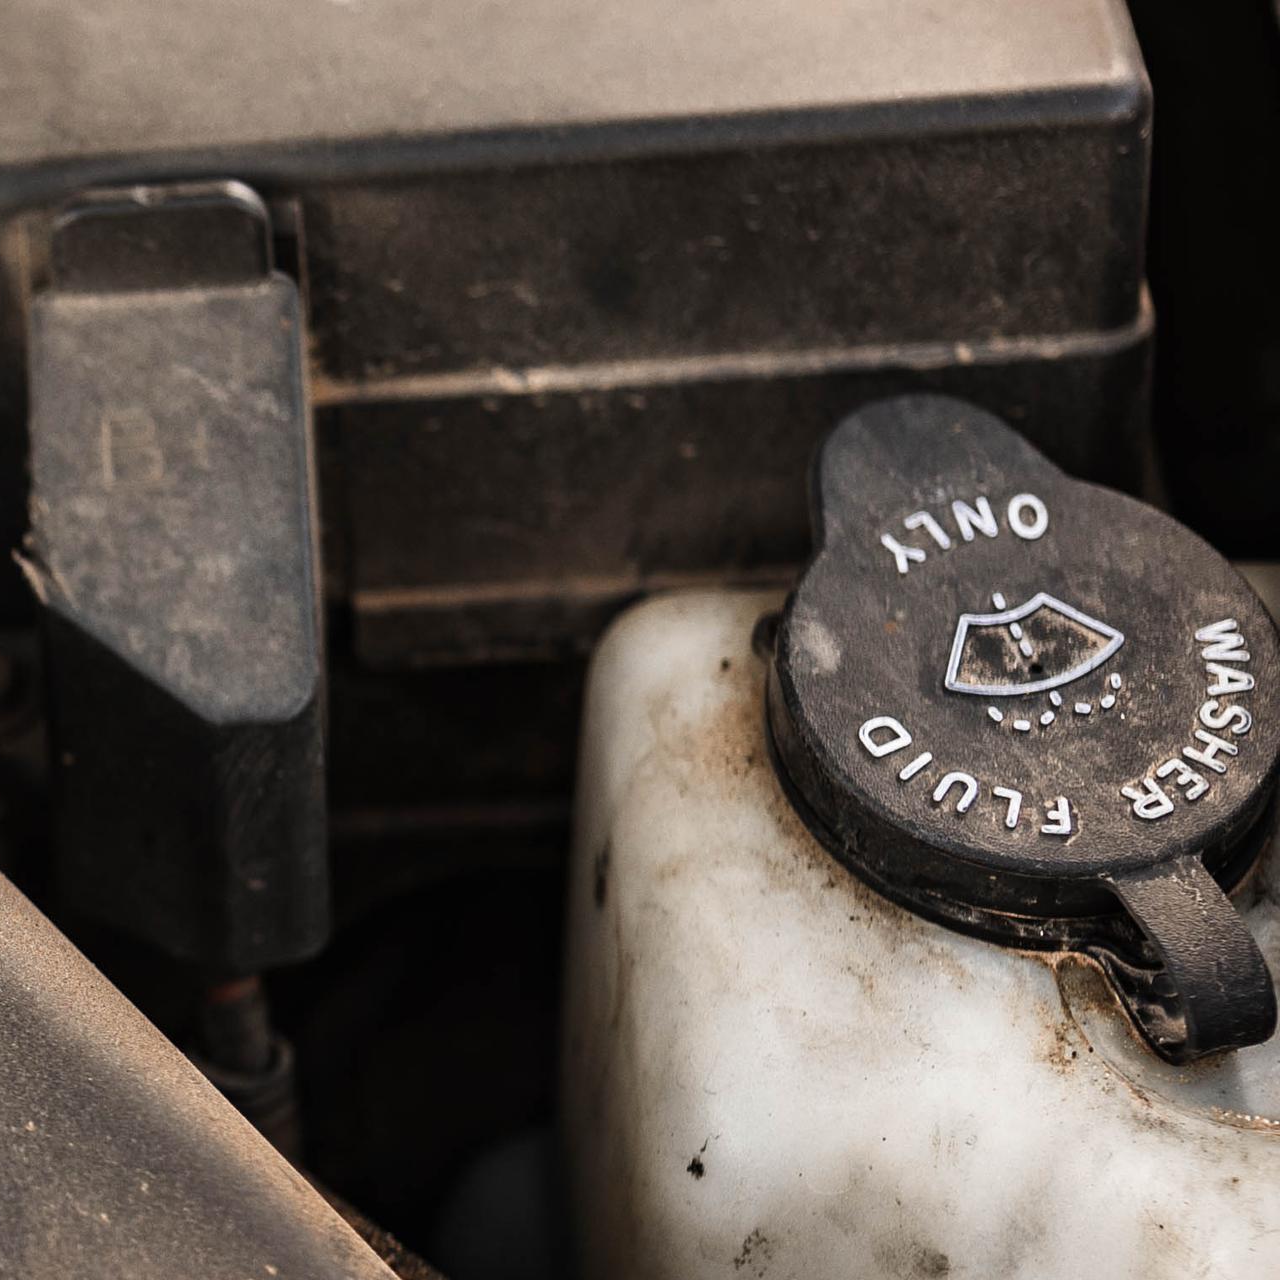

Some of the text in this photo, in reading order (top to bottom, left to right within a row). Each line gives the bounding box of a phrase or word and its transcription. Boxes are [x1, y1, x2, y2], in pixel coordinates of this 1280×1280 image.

[858, 493, 1255, 835] WASHER FLUID ONLY
